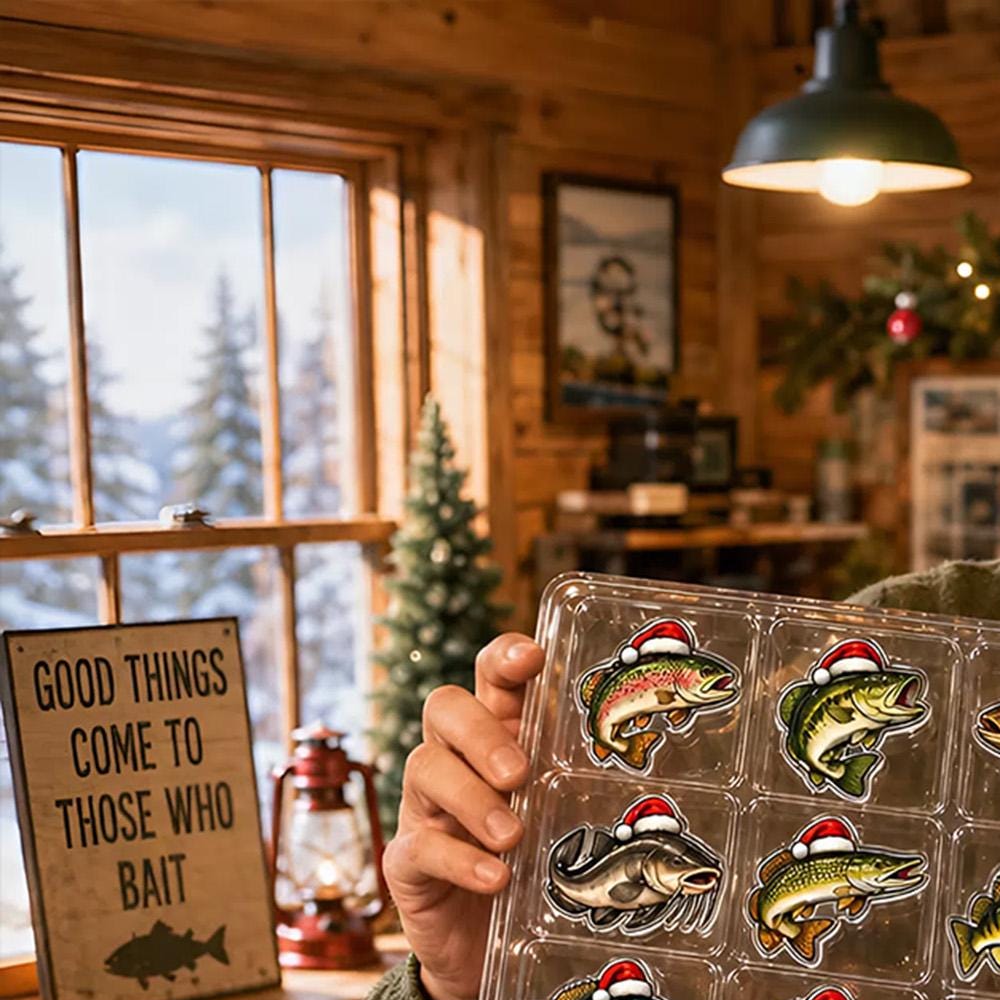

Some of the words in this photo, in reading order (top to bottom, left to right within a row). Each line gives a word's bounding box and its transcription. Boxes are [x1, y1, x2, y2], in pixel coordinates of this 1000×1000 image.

[33, 657, 115, 712] GOOD
[124, 647, 228, 703] THINGS
[70, 721, 157, 778] COME
[164, 717, 204, 768] TO
[55, 790, 157, 849] THOSE
[164, 781, 235, 835] WHO
[118, 853, 187, 911] BAIT
